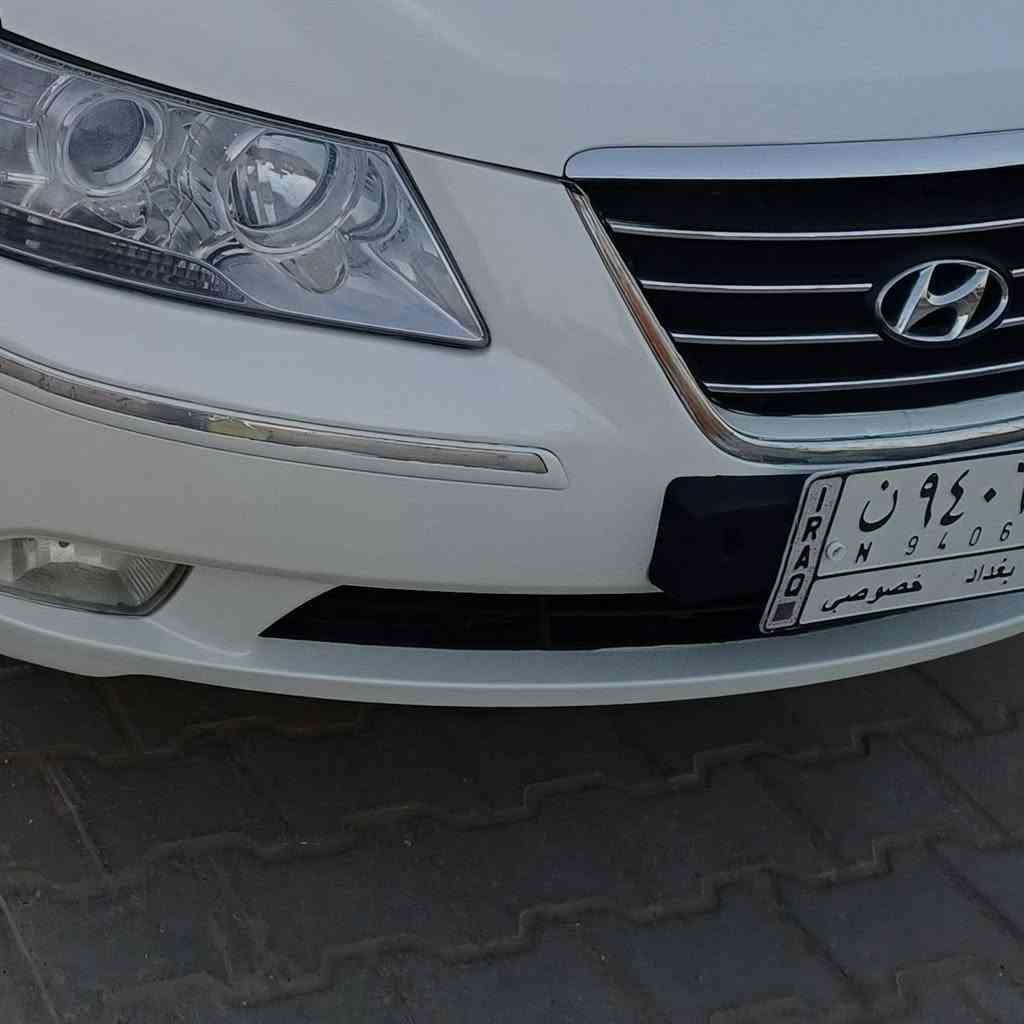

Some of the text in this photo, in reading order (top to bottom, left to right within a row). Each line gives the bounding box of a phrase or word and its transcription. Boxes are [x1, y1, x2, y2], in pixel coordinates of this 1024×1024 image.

[784, 486, 826, 598] IRAQ
[821, 558, 1015, 613] بغداد خصوصي
